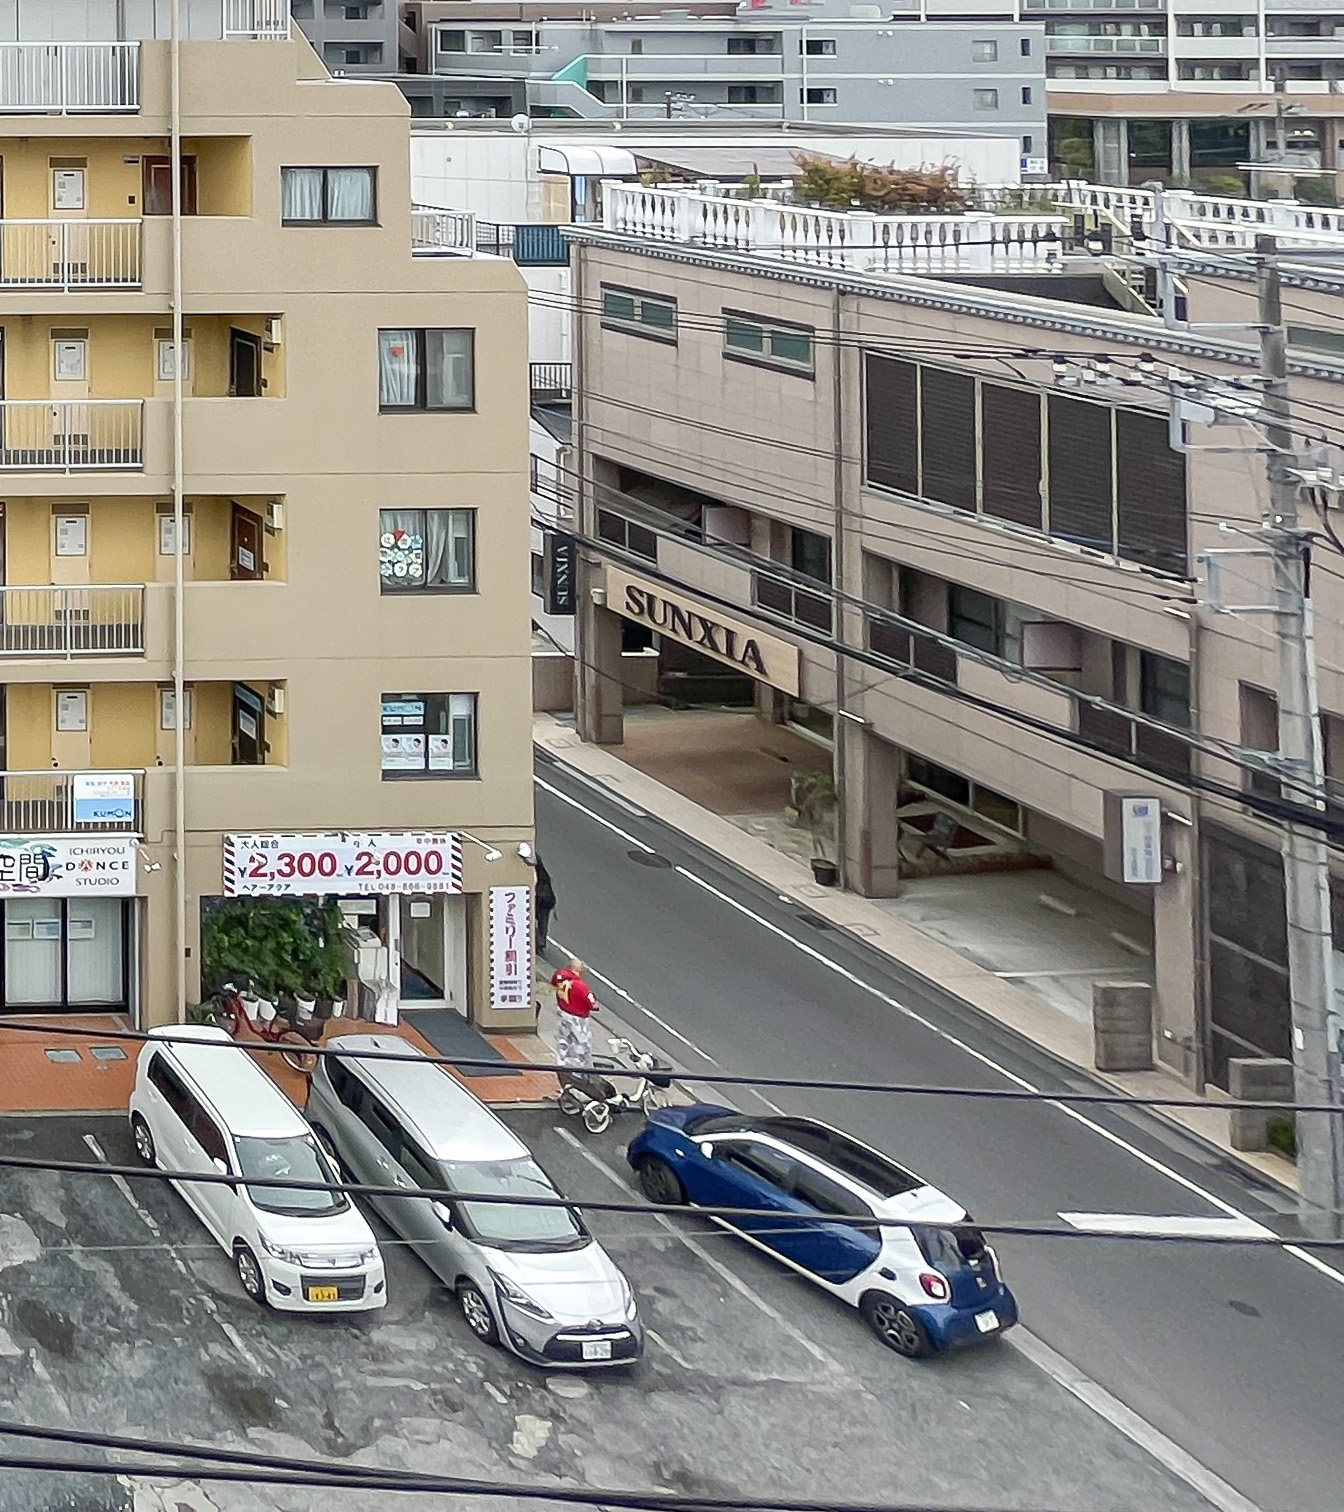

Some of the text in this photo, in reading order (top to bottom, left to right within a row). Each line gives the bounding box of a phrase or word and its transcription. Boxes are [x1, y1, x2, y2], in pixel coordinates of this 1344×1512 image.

[625, 584, 769, 678] SUNXIA
[93, 808, 132, 818] KUMON
[65, 859, 130, 872] DANCE
[75, 877, 120, 887] STUDIO
